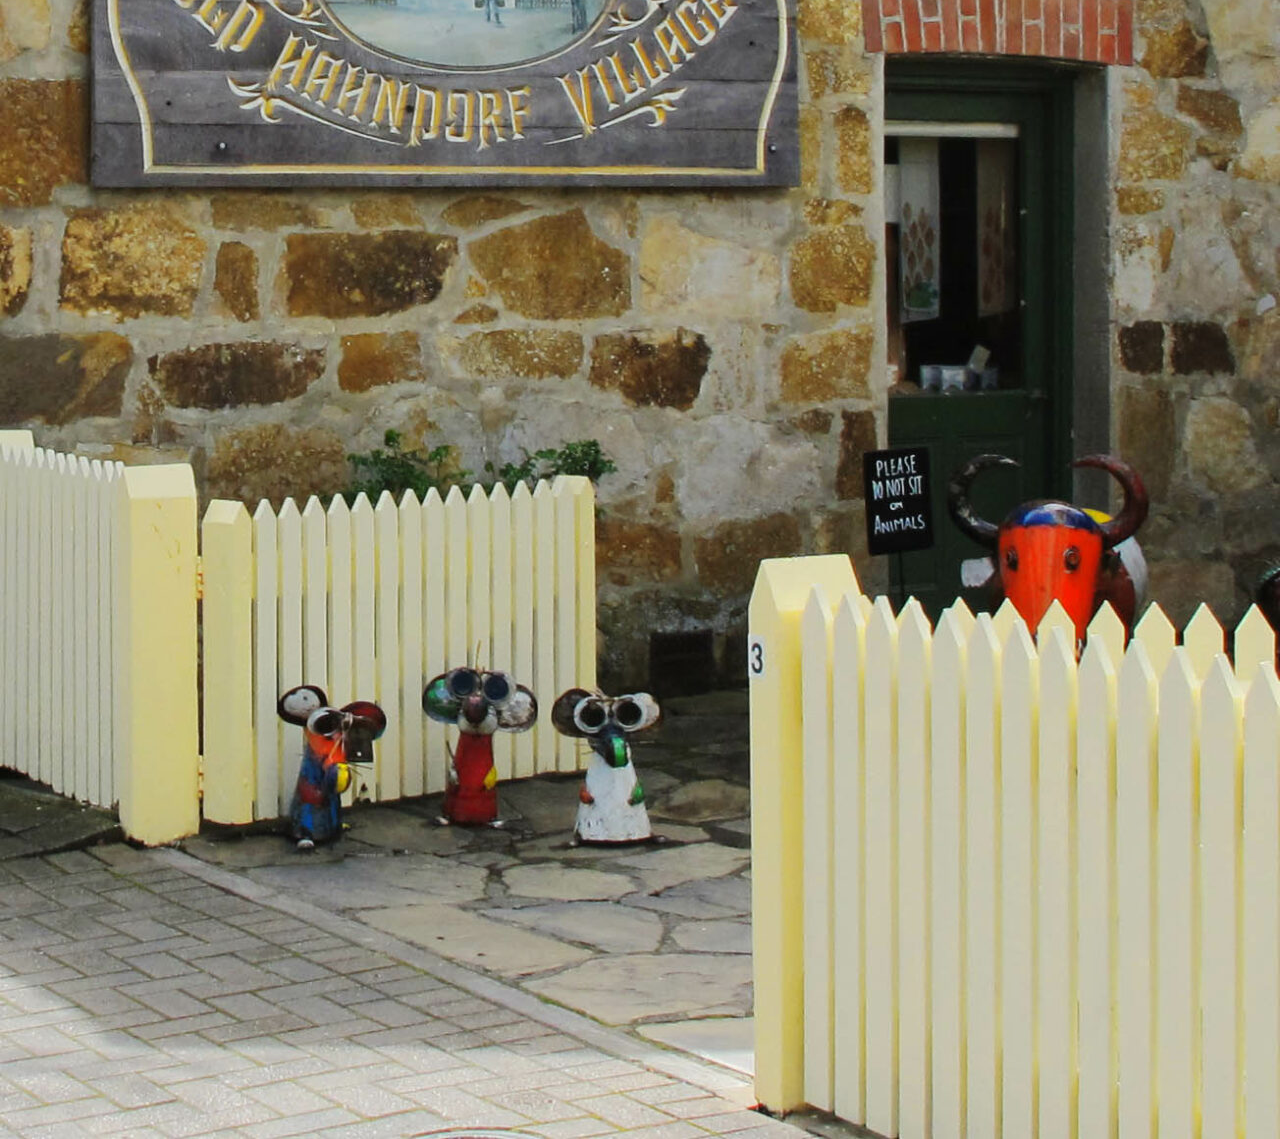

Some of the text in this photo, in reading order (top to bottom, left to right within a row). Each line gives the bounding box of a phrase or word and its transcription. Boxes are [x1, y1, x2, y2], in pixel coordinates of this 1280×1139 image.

[267, 31, 532, 151] HAHNDORF
[876, 454, 917, 478] PLEASE
[872, 475, 923, 500] DO NOT SIT
[751, 642, 763, 674] 3
